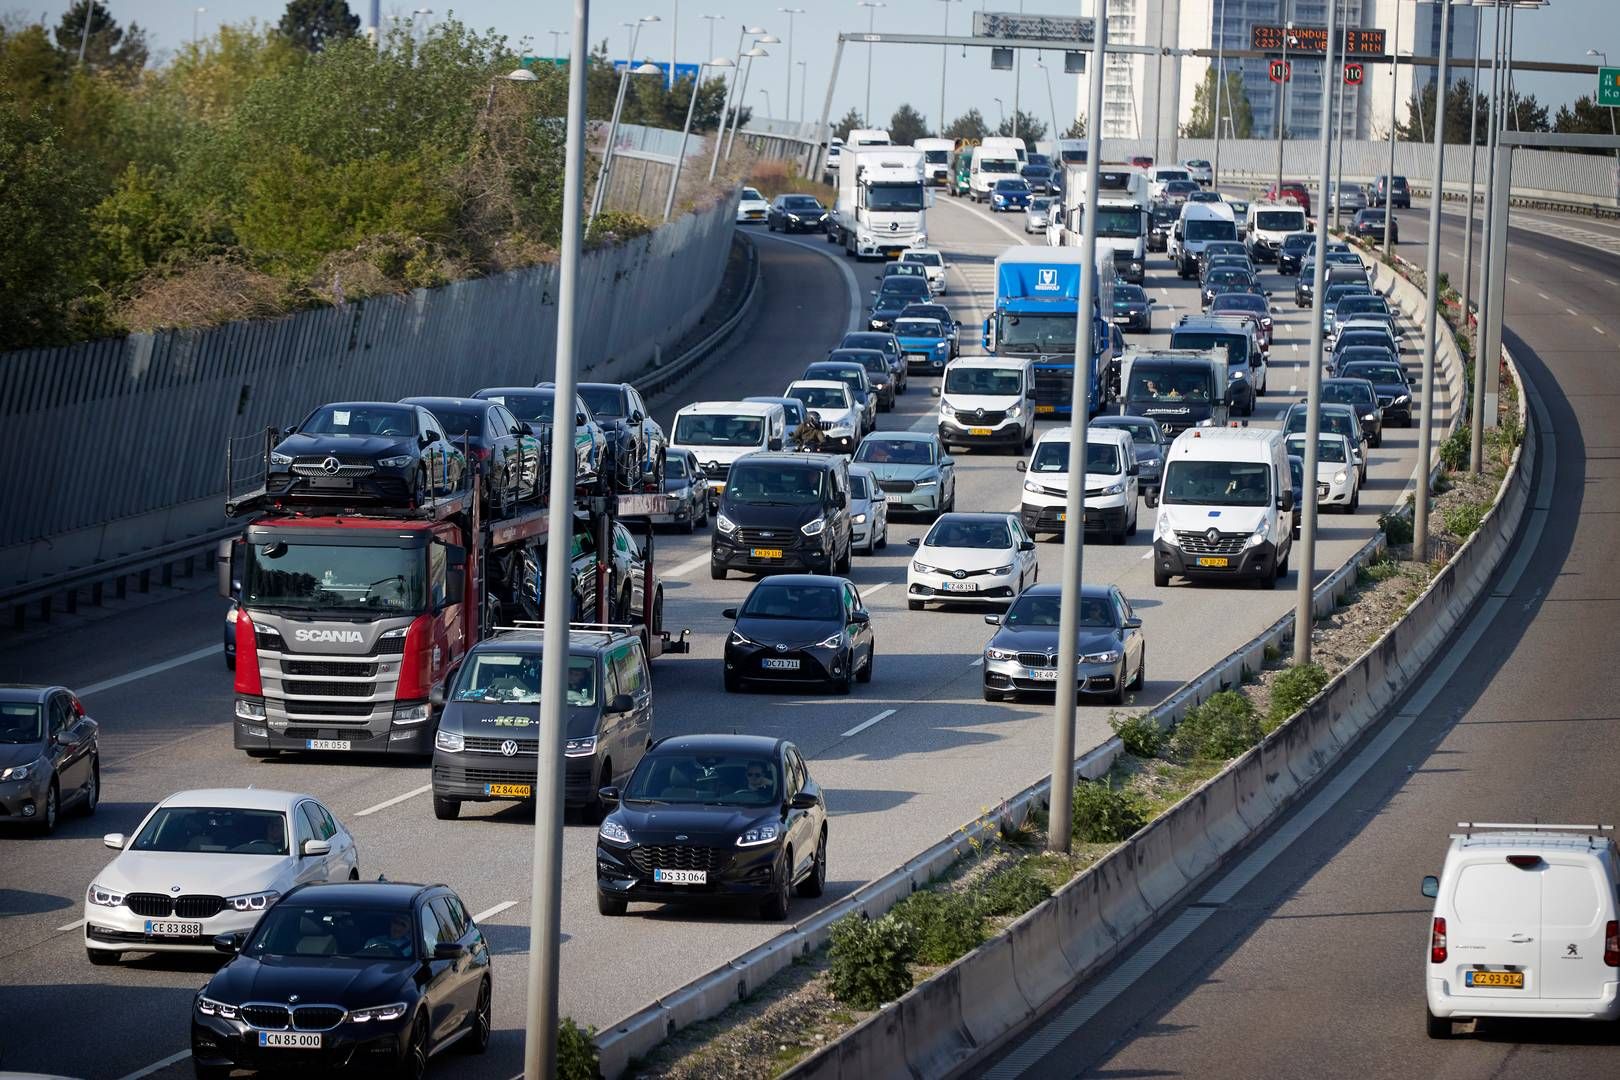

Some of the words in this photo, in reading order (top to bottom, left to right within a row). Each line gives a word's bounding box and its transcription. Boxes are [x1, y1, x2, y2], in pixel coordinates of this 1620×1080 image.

[1348, 32, 1355, 40] 2
[1361, 32, 1382, 41] MIN
[1348, 42, 1355, 51] 3
[1361, 43, 1381, 52] MIN
[1346, 67, 1361, 79] 110
[295, 629, 364, 643] SCANIA
[313, 741, 330, 749] RXR
[490, 786, 502, 794] AZ
[502, 786, 514, 794] 84
[514, 786, 529, 795] 440
[661, 871, 674, 881] DS
[675, 872, 686, 881] 33
[688, 872, 705, 882] 064
[152, 923, 165, 933] CE
[167, 923, 179, 933] 83
[180, 924, 199, 934] 888
[1473, 973, 1487, 983] CZ
[1489, 974, 1501, 984] 93
[1503, 974, 1521, 984] 914
[267, 1034, 282, 1045] CN
[284, 1035, 297, 1045] 85
[299, 1035, 320, 1046] 000
